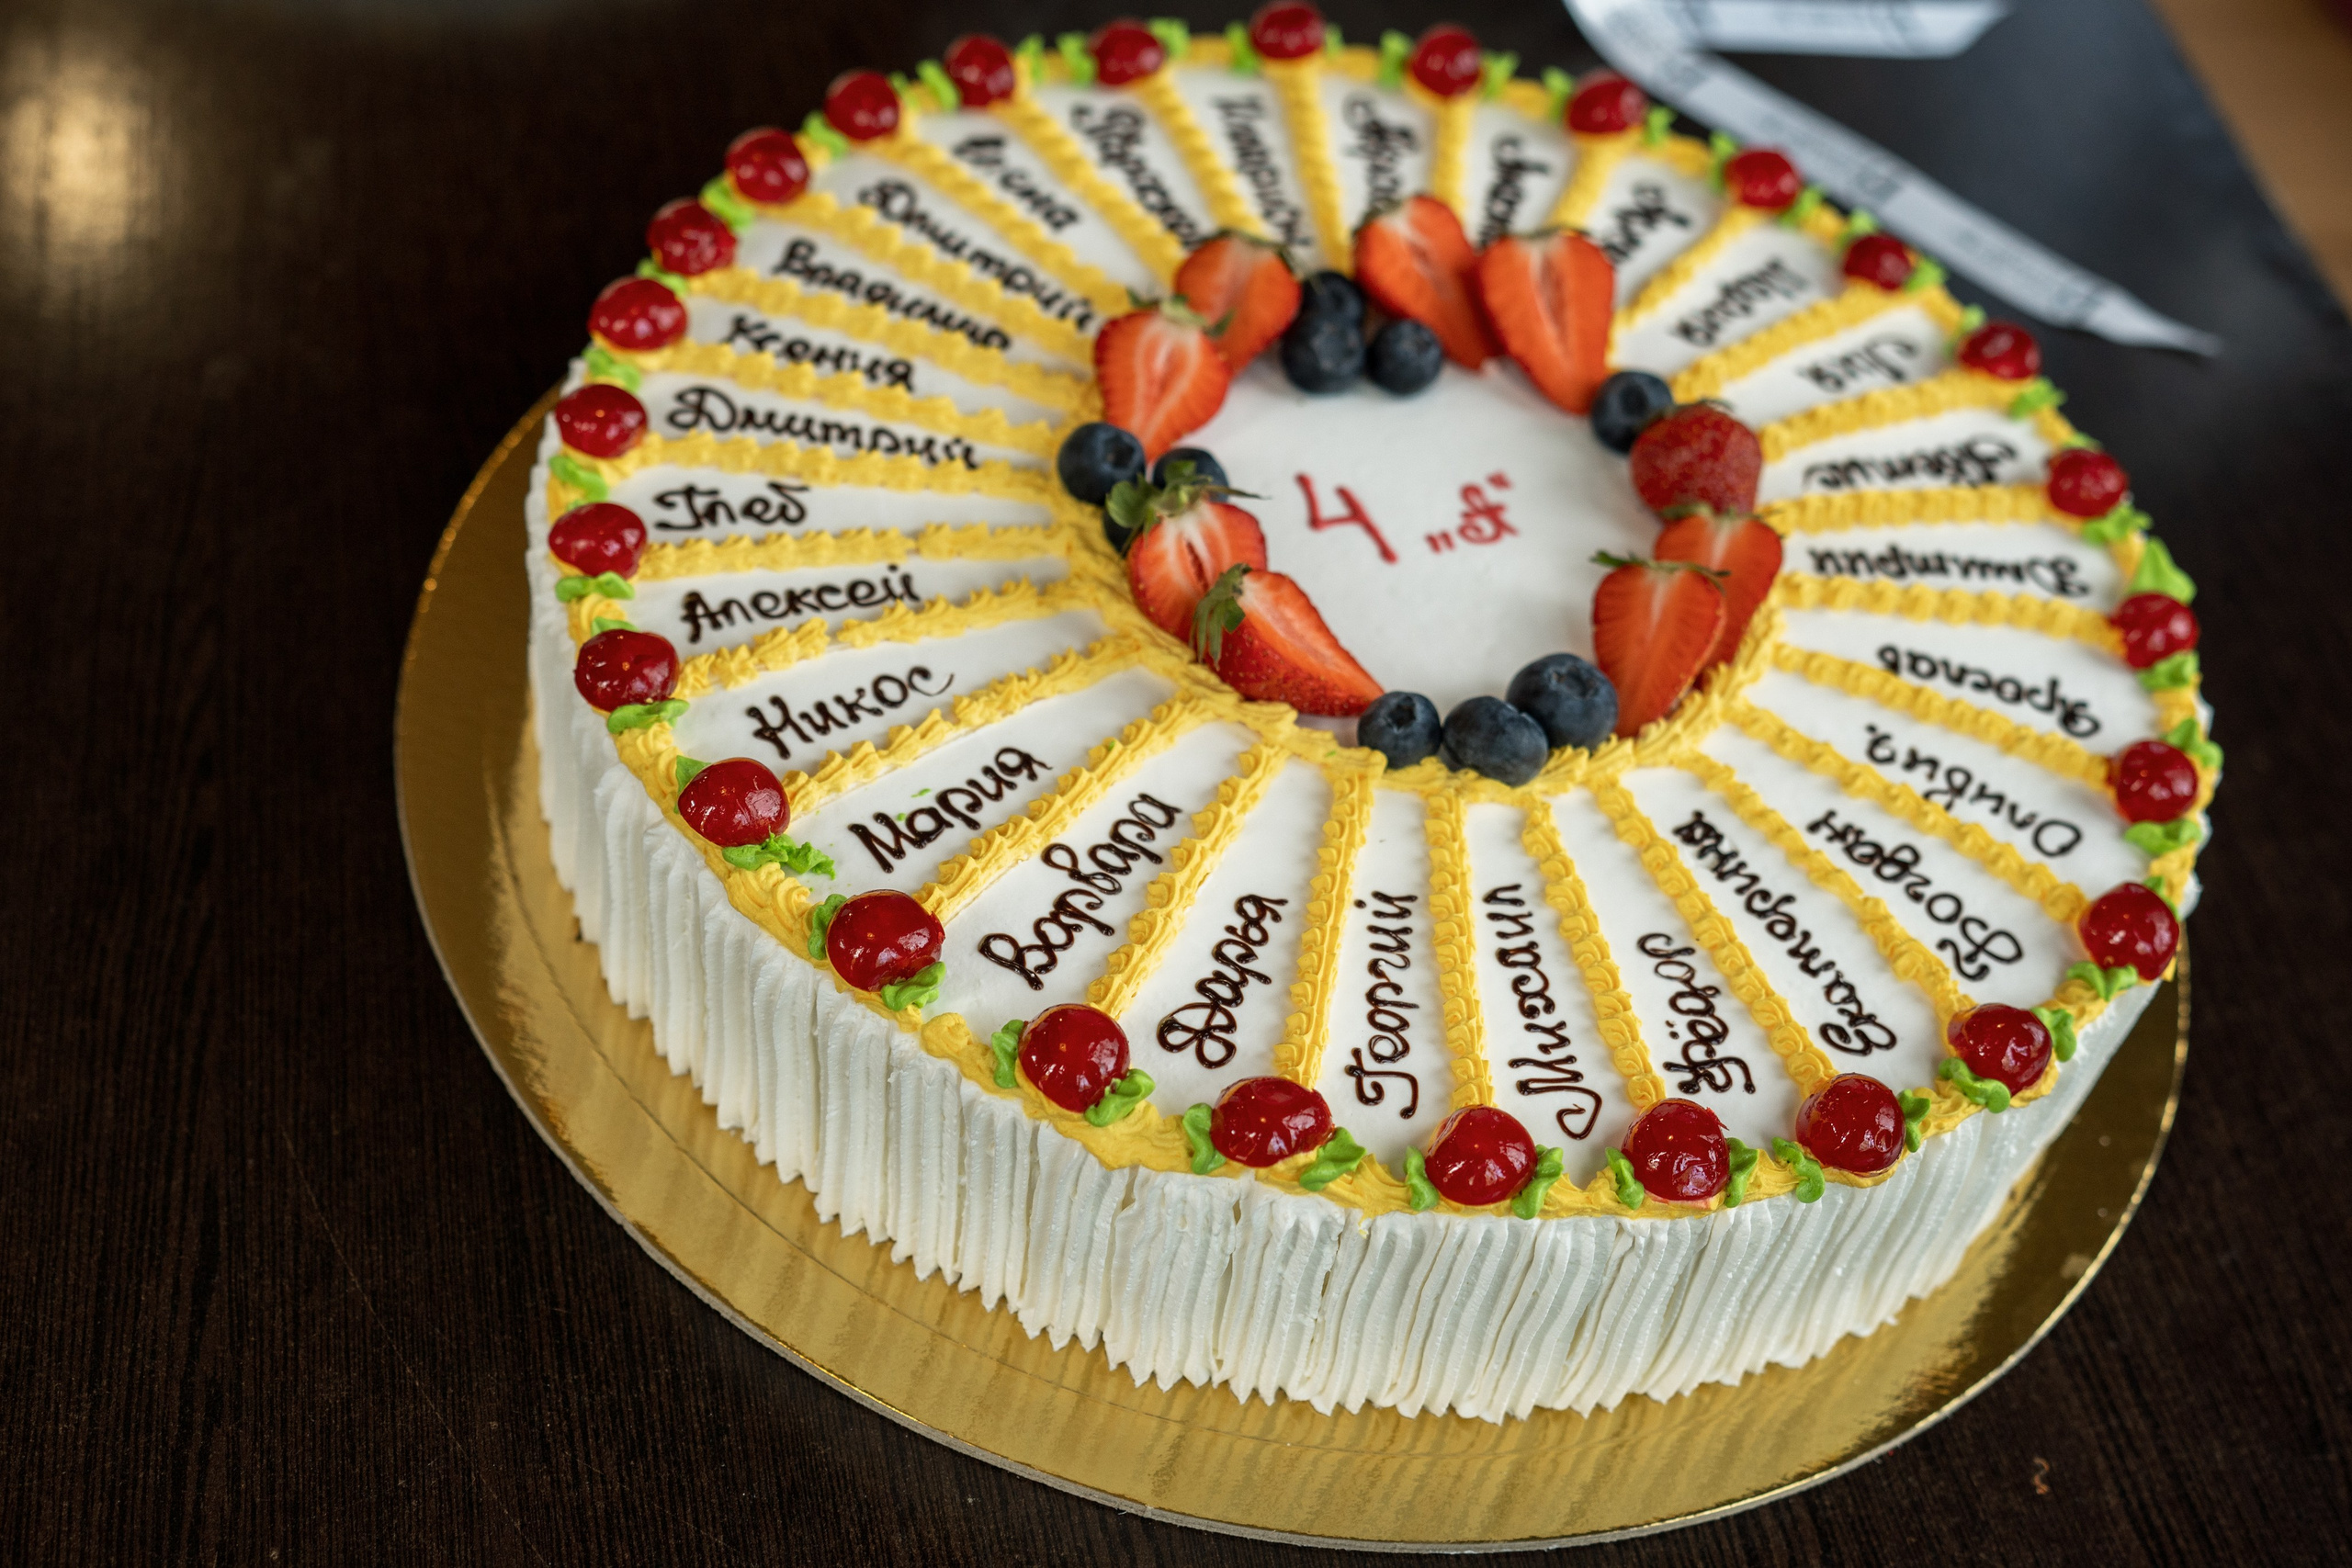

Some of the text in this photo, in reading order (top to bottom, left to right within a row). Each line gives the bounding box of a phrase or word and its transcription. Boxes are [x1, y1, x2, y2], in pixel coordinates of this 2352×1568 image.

[726, 316, 912, 391] Ксения
[667, 387, 977, 468] Дмитрий
[654, 482, 808, 530] Глеб
[1295, 471, 1398, 564] 4
[681, 565, 920, 644] Алексей
[746, 667, 953, 760] Никос
[1879, 647, 2099, 738] Ярослав
[848, 748, 1051, 873] Мария
[978, 794, 1182, 990] Варвара
[1673, 811, 1896, 1056] Екатерина
[1807, 811, 2023, 981] Богдан
[1158, 895, 1288, 1069] Дарья
[1347, 892, 1419, 1119] Георгий
[1484, 885, 1600, 1140] Михаил
